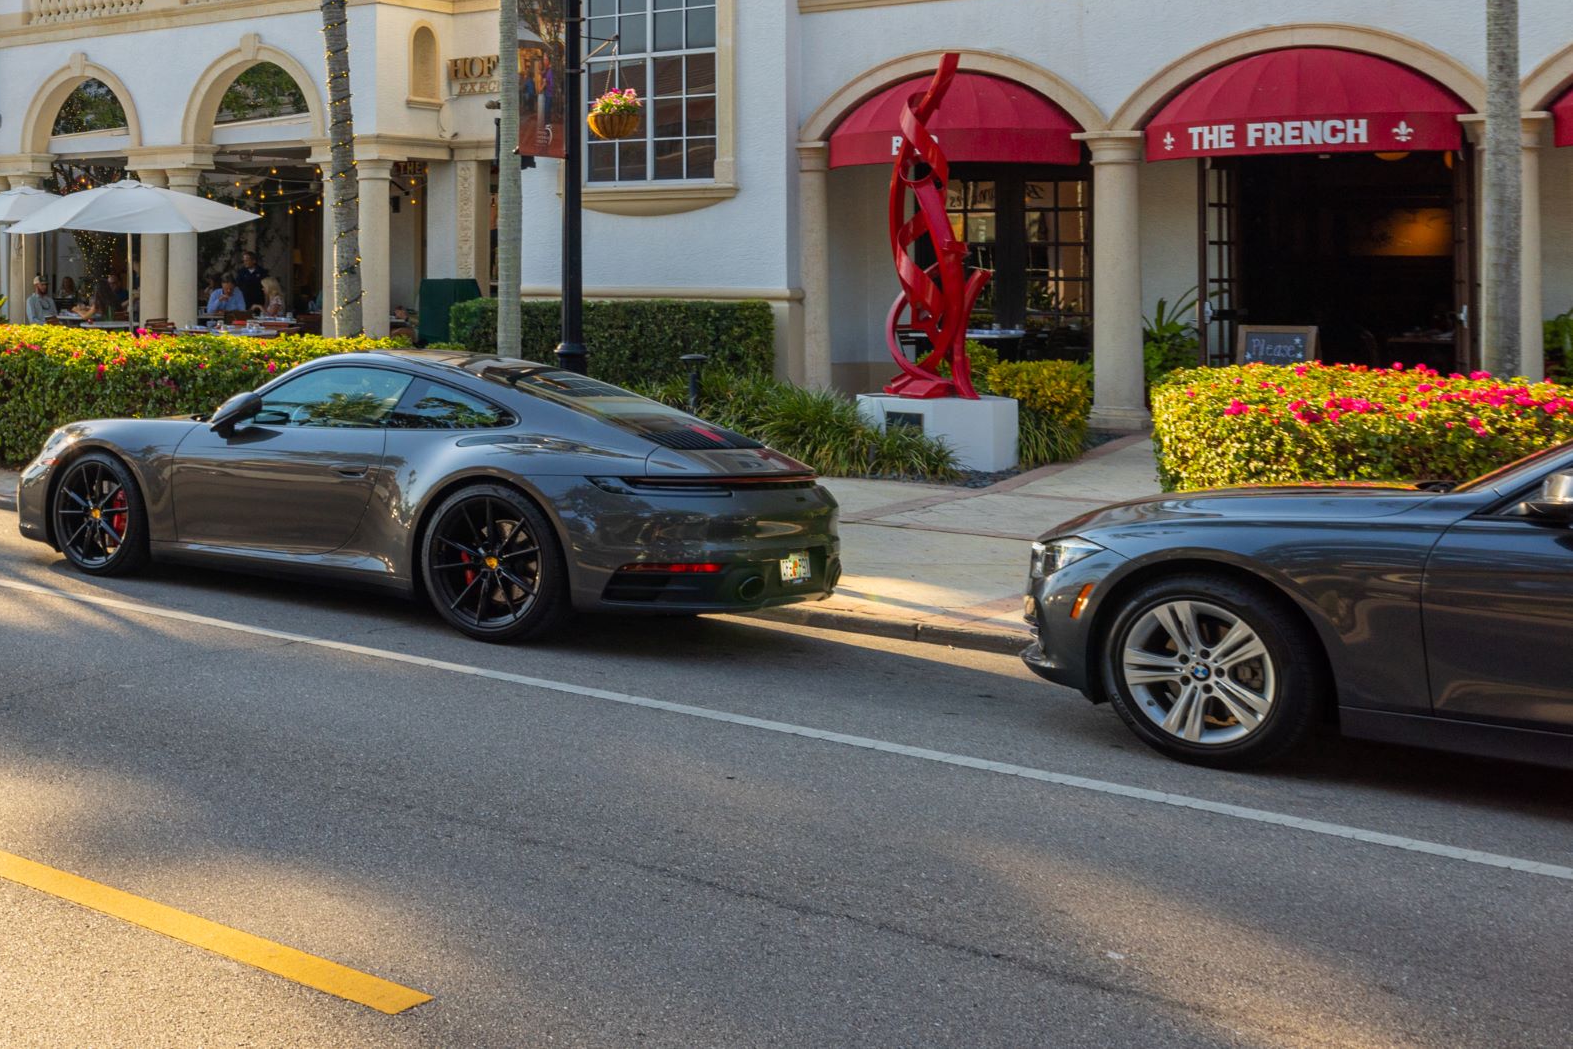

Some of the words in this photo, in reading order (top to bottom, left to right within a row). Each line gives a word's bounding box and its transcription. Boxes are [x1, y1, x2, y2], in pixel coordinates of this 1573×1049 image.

[448, 55, 499, 80] HOF
[458, 81, 499, 96] EXEC
[1188, 124, 1235, 150] THE
[1246, 118, 1368, 147] FRENCH
[1252, 338, 1296, 358] Please
